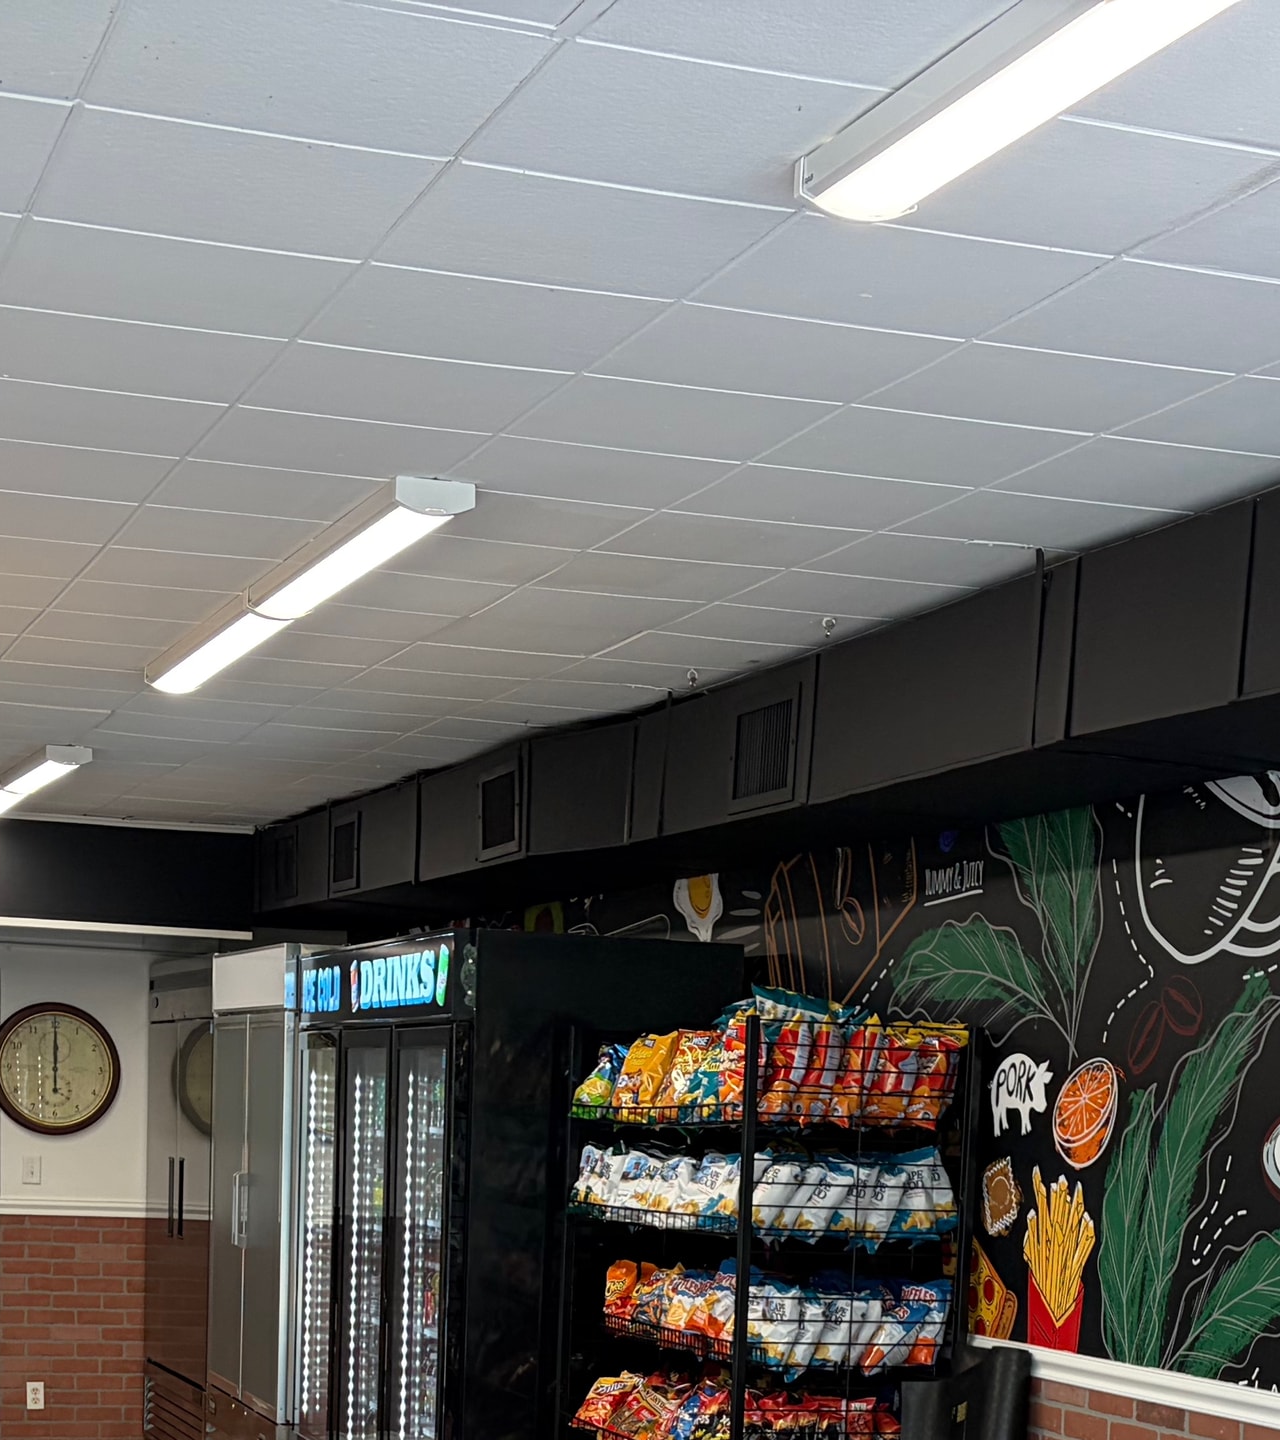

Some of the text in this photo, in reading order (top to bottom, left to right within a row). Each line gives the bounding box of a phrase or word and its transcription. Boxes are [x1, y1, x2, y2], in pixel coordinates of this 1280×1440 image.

[360, 950, 436, 1010] DRINKS
[28, 1025, 38, 1035] 11
[11, 1041, 22, 1050] 10
[996, 1060, 1036, 1107] PORK
